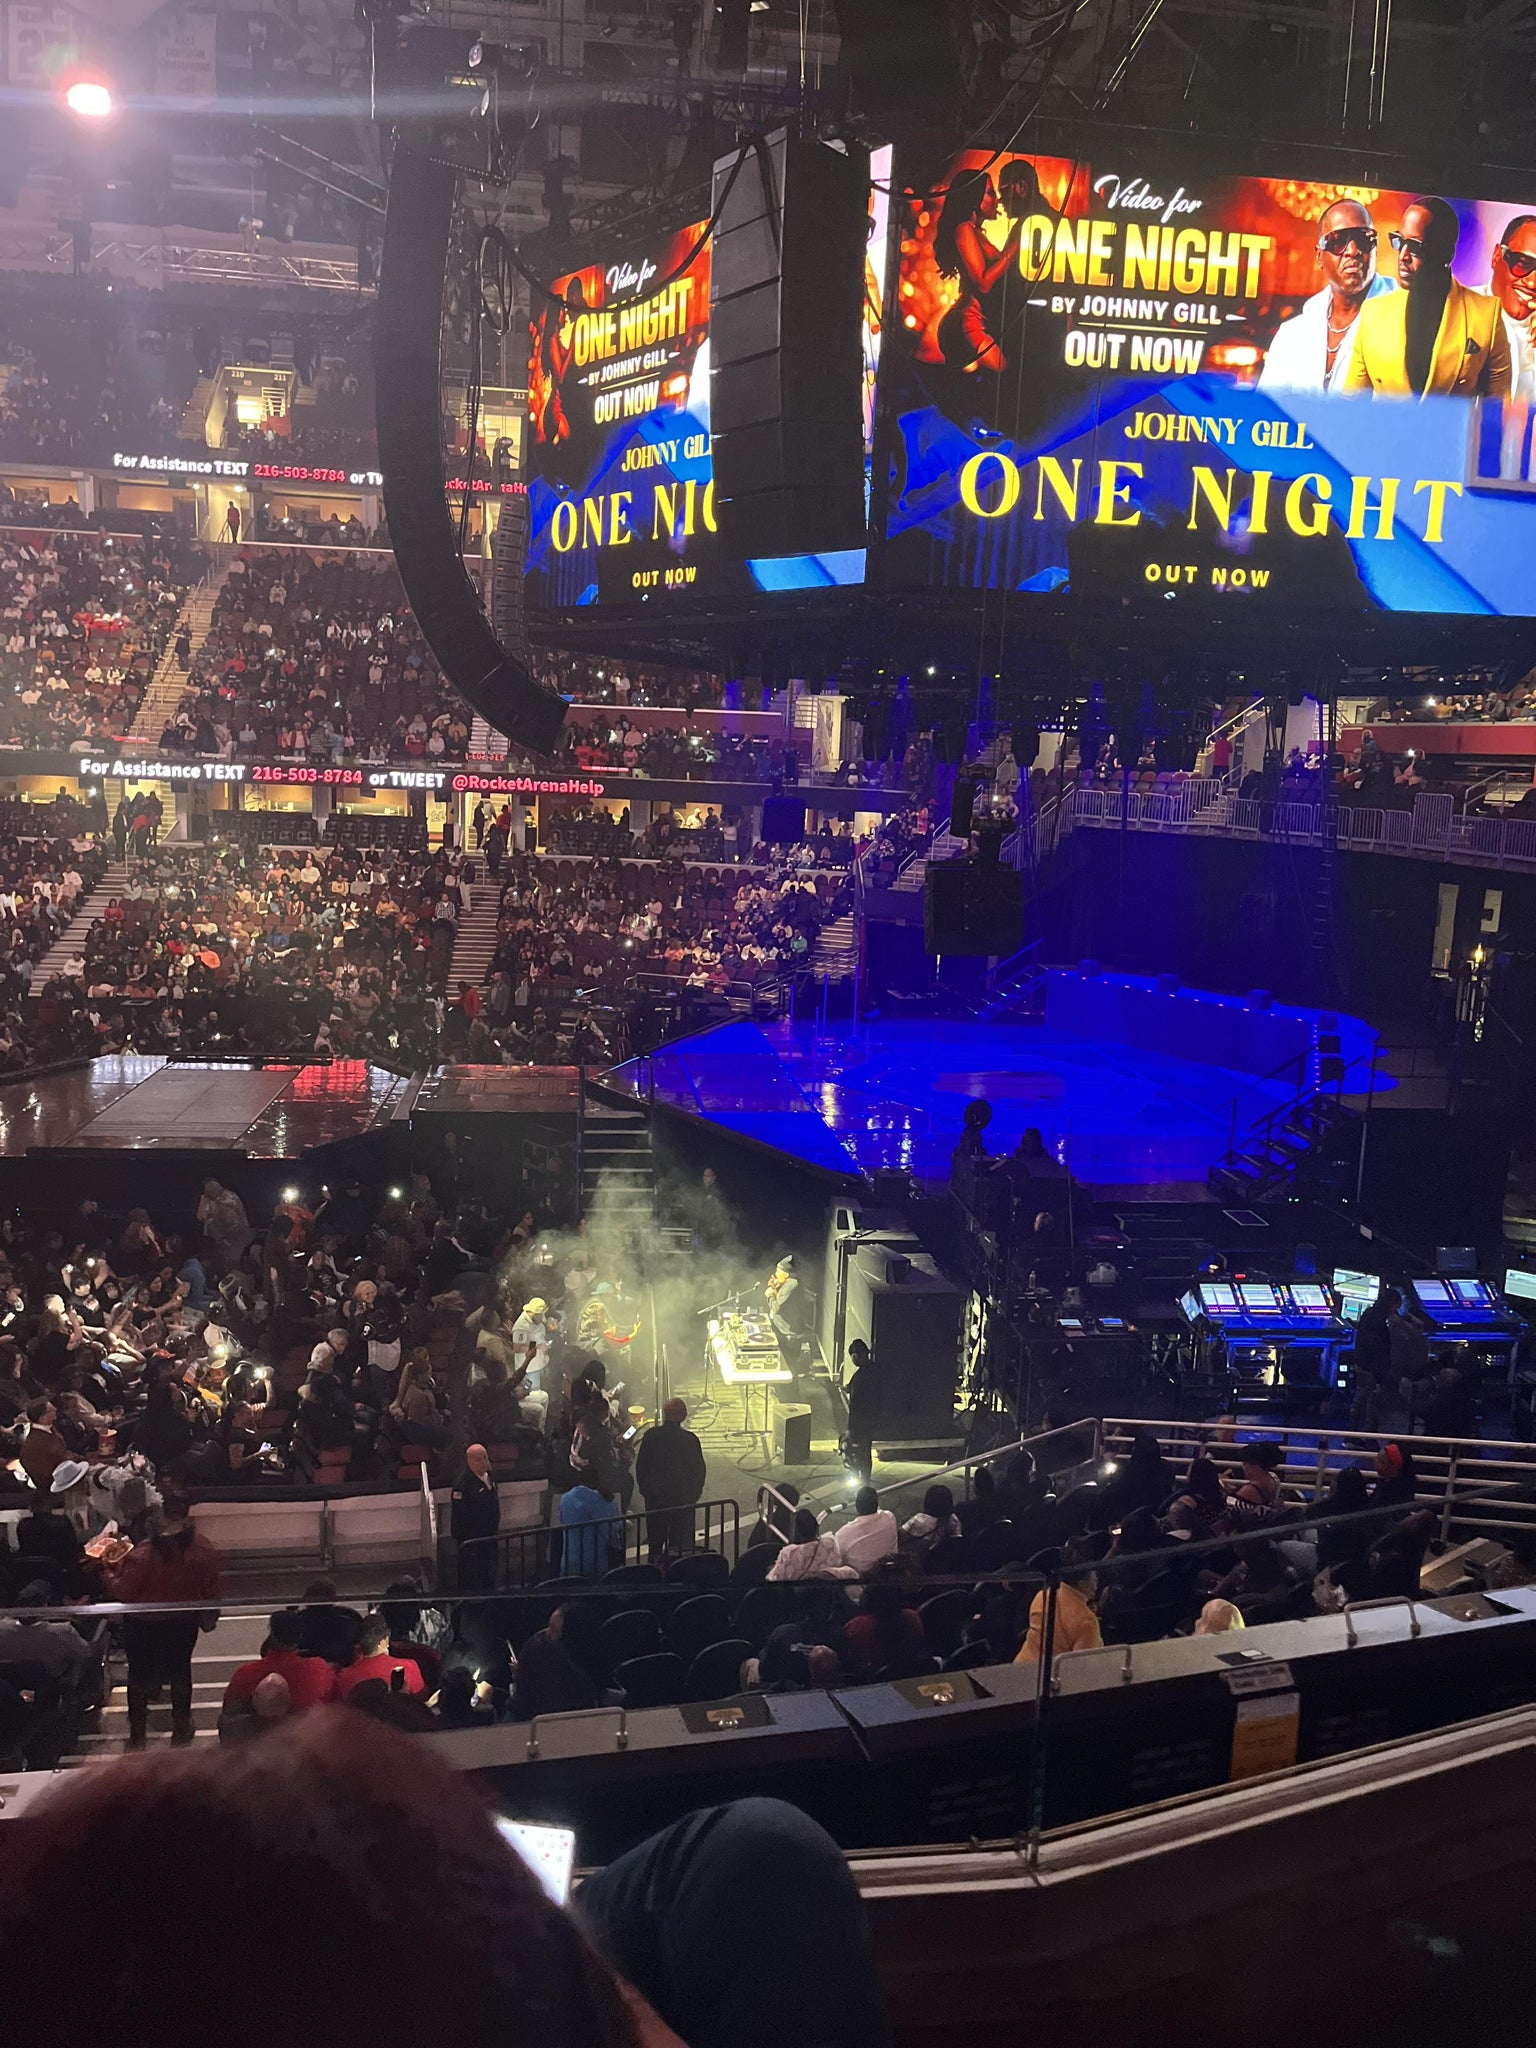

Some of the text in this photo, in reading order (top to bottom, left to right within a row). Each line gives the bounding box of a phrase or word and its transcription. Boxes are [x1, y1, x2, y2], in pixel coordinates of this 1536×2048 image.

[1094, 174, 1202, 224] Video for
[605, 258, 657, 294] Video for
[1018, 214, 1272, 299] ONE NIGHT
[574, 277, 694, 367] ONE NIGHT
[1051, 295, 1222, 325] BY JOHNNY GILL
[588, 348, 668, 386] BY JOHNNY GILL
[1064, 331, 1205, 375] OUT NOW
[513, 392, 526, 400] 212
[594, 380, 660, 425] OUT NOW
[1124, 411, 1315, 450] JOHNNY GILL
[113, 453, 138, 468] For
[140, 455, 212, 473] Assistance
[214, 460, 249, 476] TEXT
[254, 463, 345, 482] 216-503-8784
[350, 473, 366, 485] or
[621, 438, 680, 473] JOHNNY
[959, 451, 1464, 543] ONE NIGHT
[551, 491, 633, 552] ONE
[632, 566, 697, 588] OUT NOW
[1145, 563, 1270, 587] OUT NOW
[80, 758, 605, 797] For Assistance TEXT 216-503-8784 or TWEET @RocketArenaHelp
